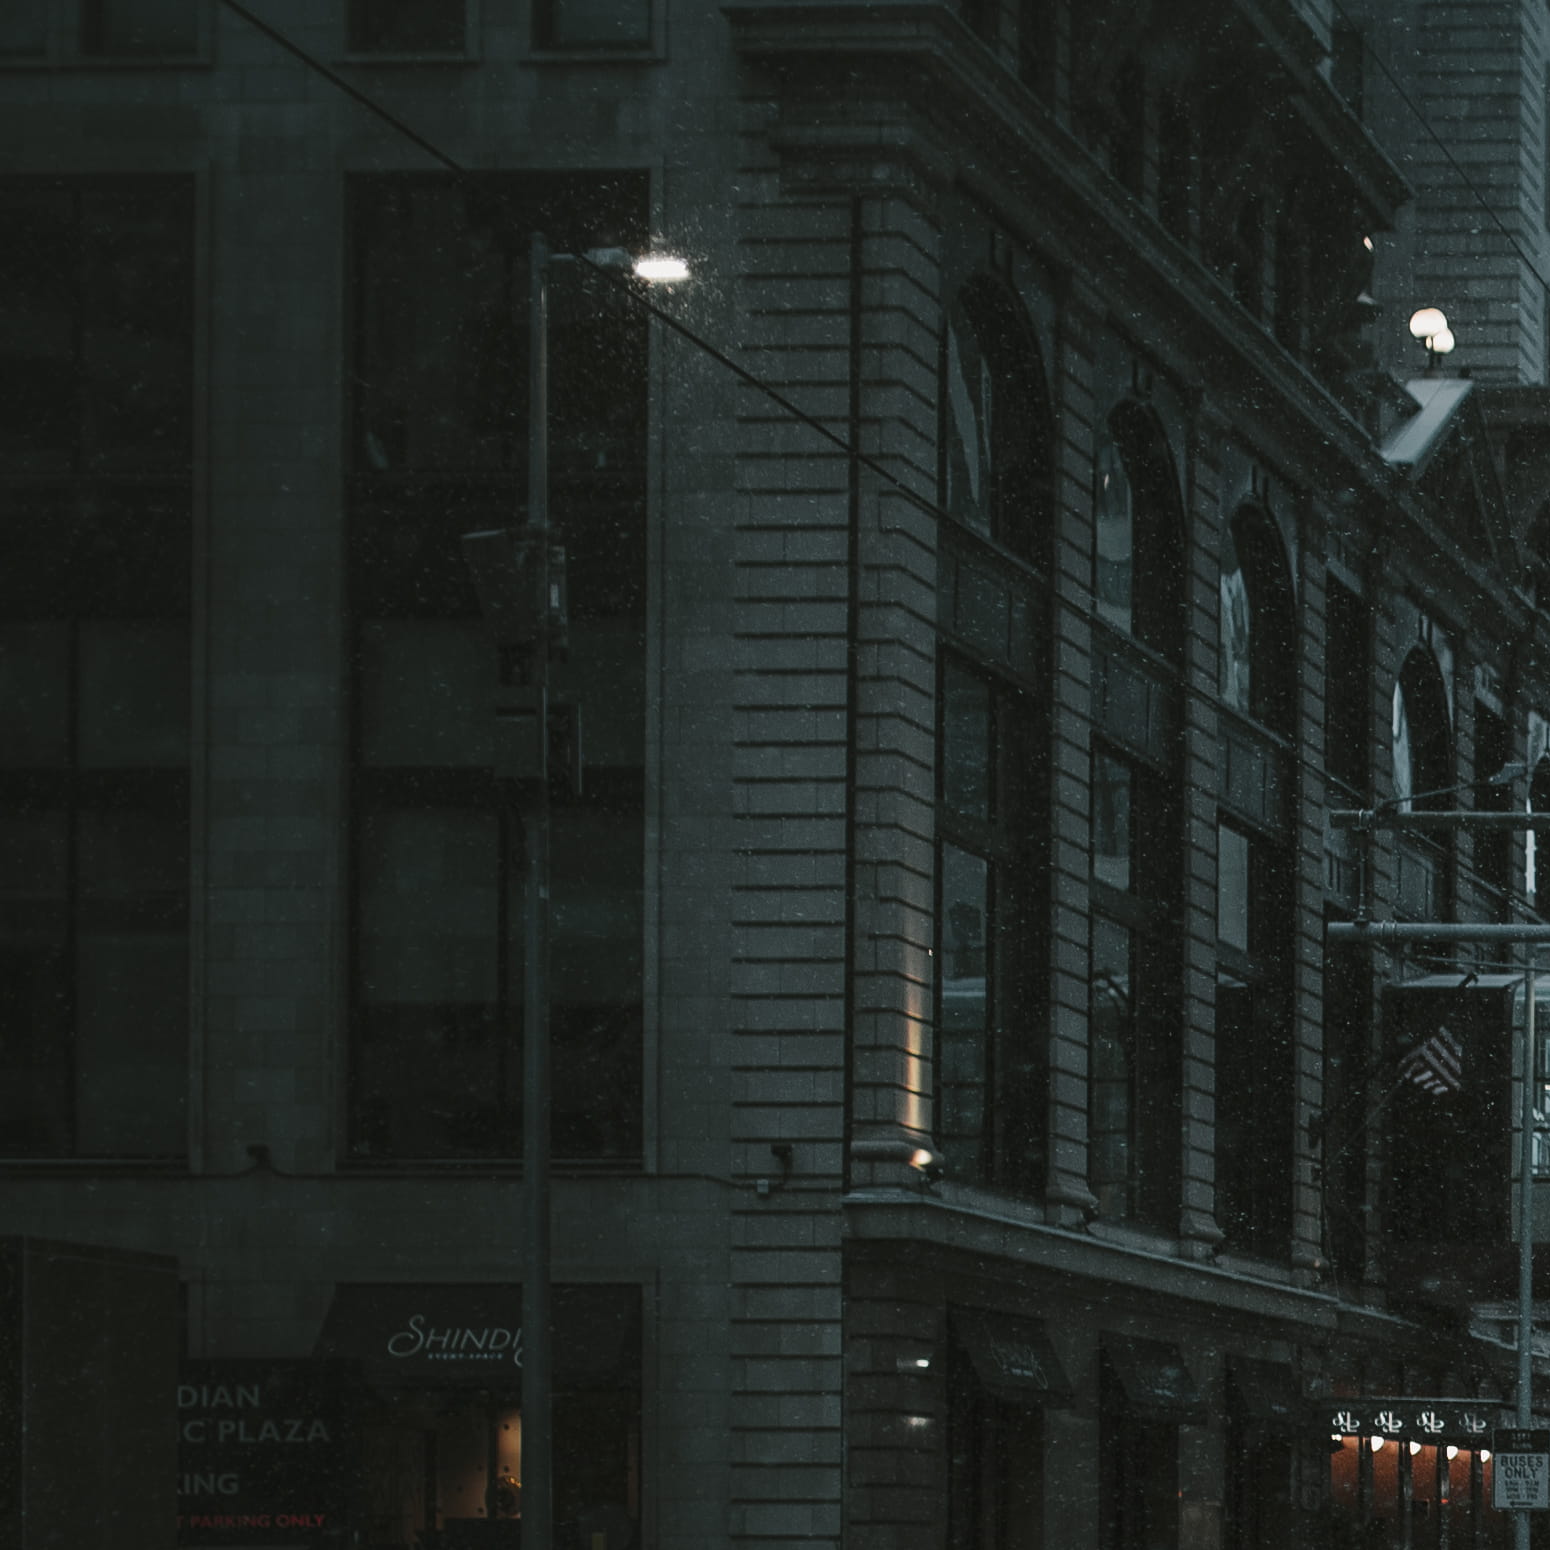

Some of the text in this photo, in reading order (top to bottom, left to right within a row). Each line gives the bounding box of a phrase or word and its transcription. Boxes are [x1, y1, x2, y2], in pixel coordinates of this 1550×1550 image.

[218, 1420, 330, 1442] PLAZA
[1501, 1455, 1543, 1467] BUSES
[1505, 1467, 1538, 1479] ONLY
[190, 1514, 272, 1528] PARKING
[275, 1513, 325, 1528] ONLY
